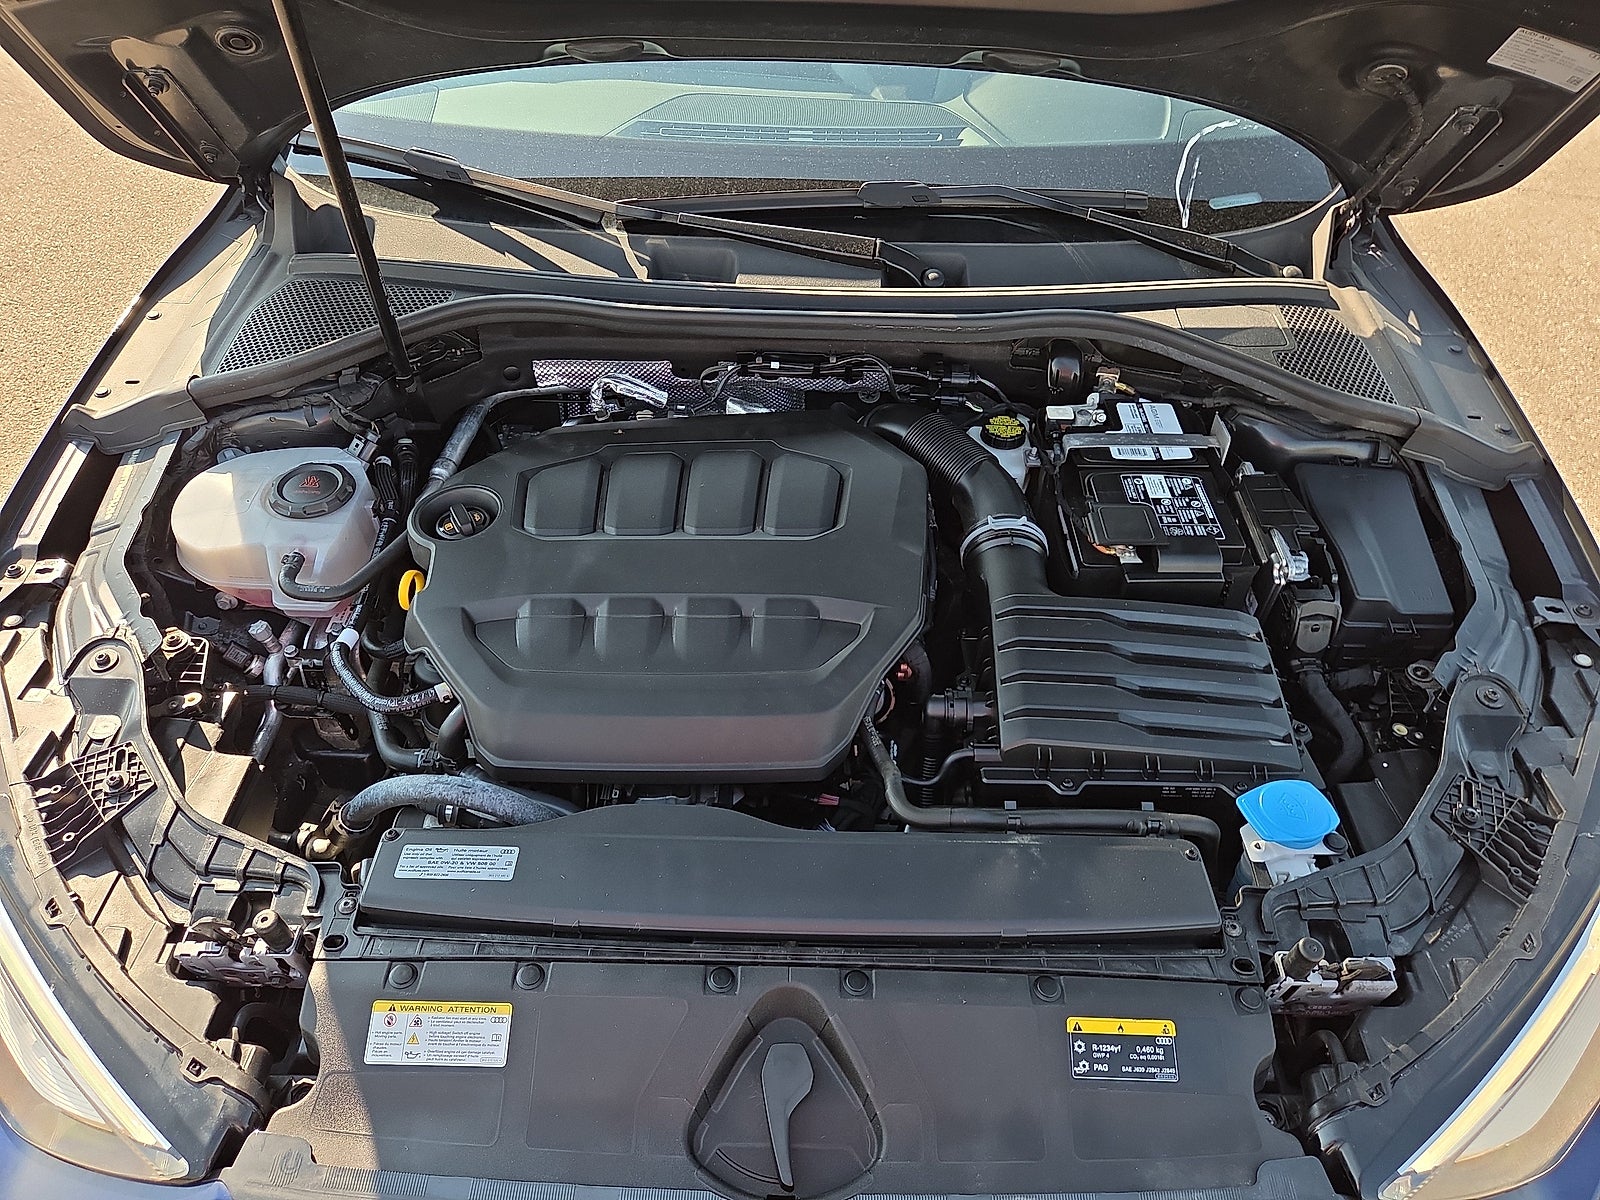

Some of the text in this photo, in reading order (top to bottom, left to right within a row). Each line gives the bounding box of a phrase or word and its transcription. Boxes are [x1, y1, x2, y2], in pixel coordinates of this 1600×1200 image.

[400, 1005, 497, 1014] WARNING ATTENTION
[1092, 1044, 1121, 1054] R-1234yf
[1155, 1046, 1164, 1055] kg
[1093, 1063, 1108, 1072] PAG
